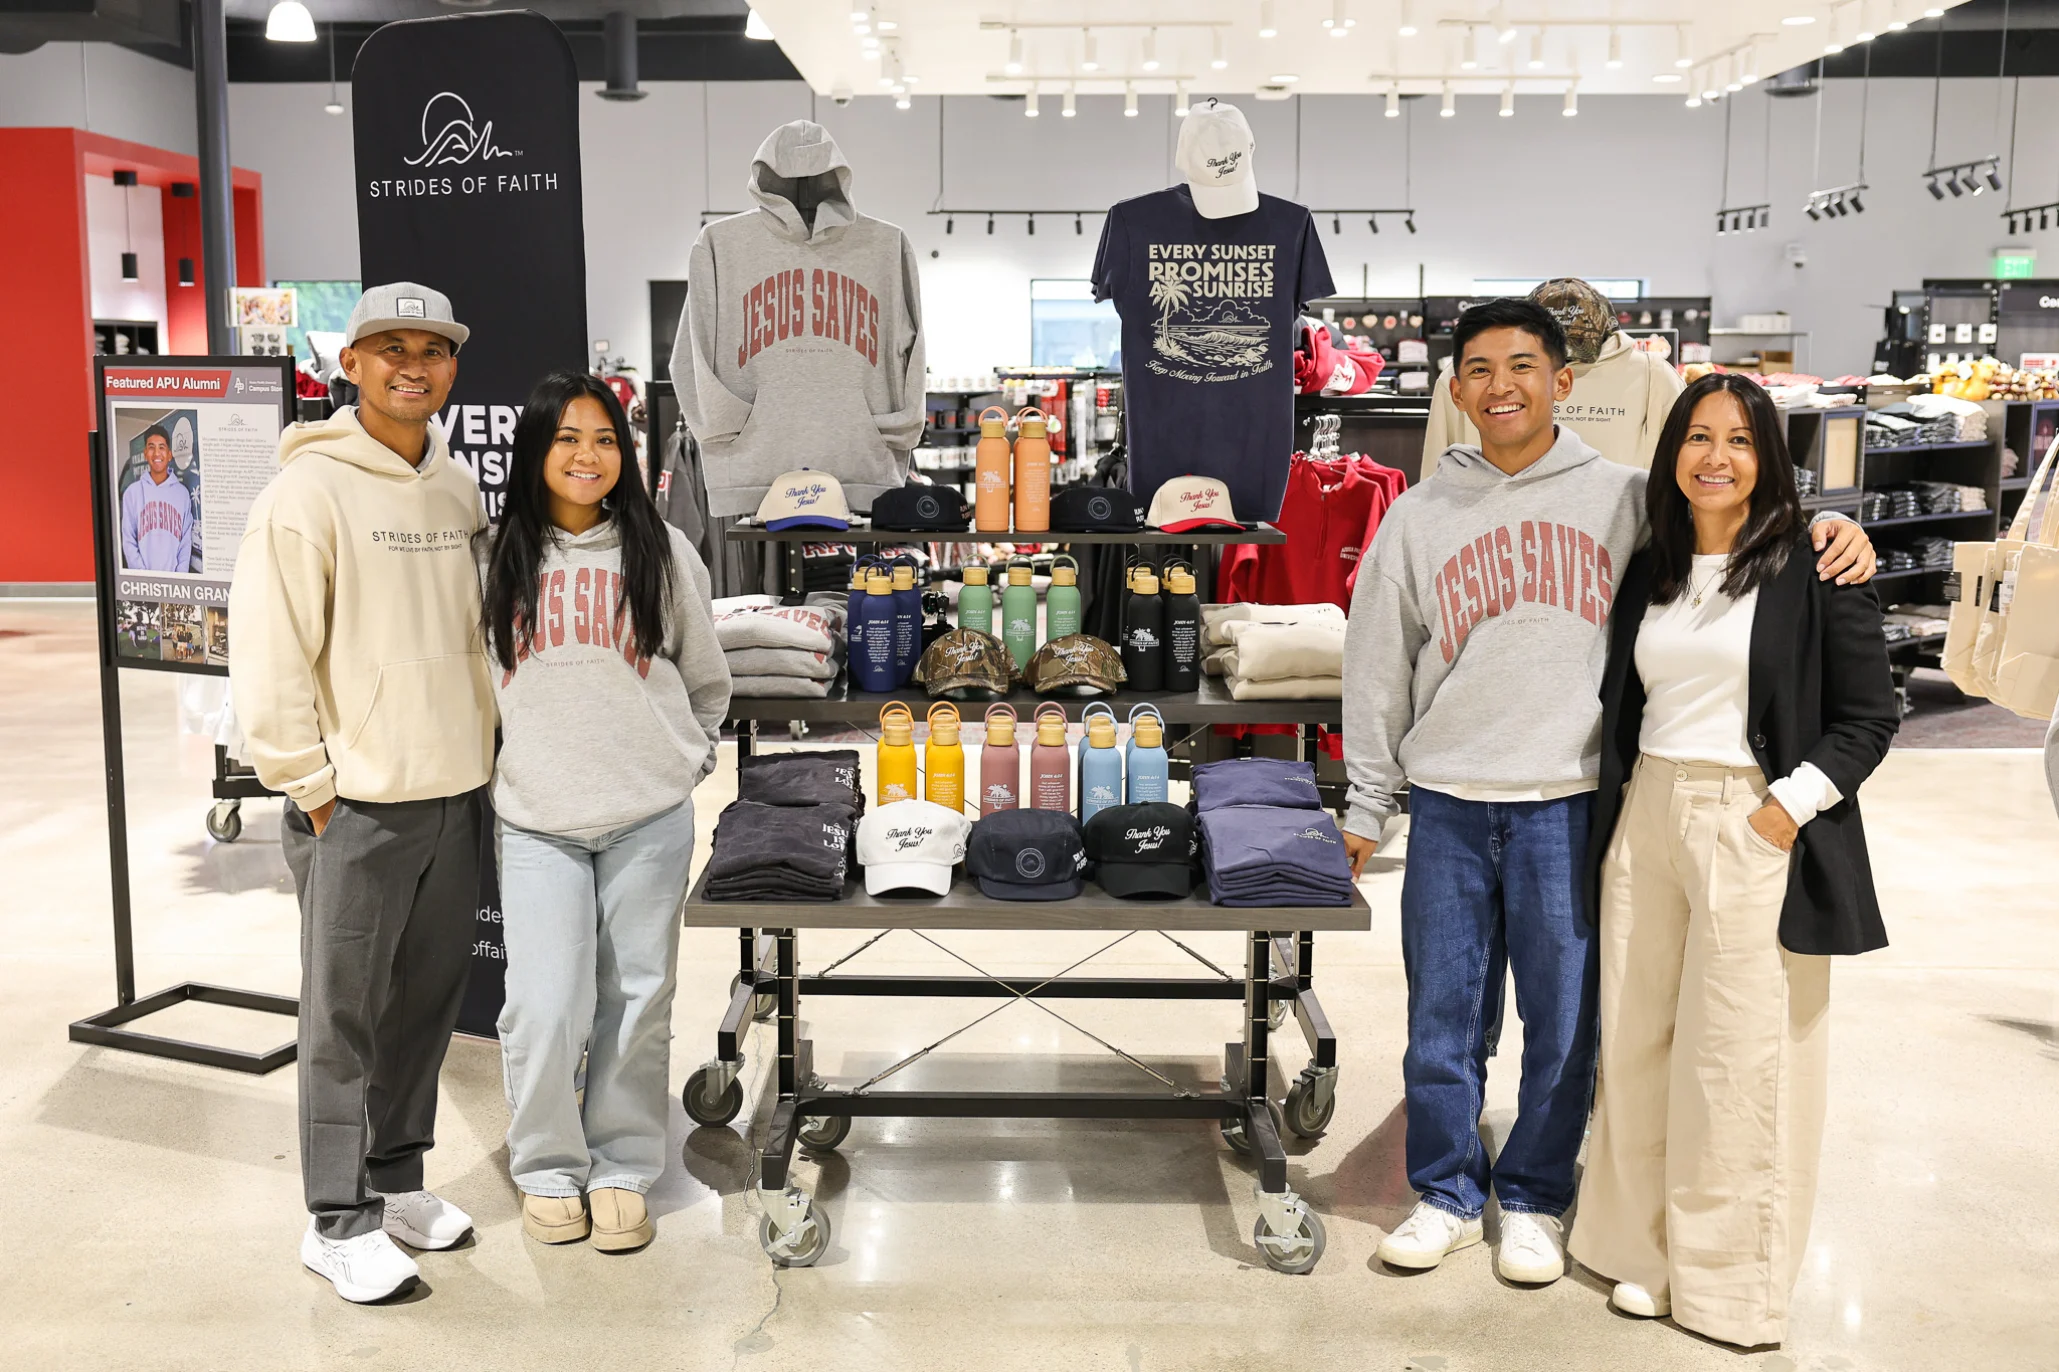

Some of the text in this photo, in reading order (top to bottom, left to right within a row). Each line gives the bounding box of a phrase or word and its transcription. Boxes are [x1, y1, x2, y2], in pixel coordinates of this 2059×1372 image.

[1206, 151, 1242, 168] Thank You
[1215, 162, 1238, 178] Jesus!
[370, 173, 557, 197] STRIDES OF FAITH
[1148, 244, 1276, 260] EVERY SUNSET
[1148, 261, 1274, 282] PROMISES
[1148, 281, 1274, 298] A SUNRISE
[738, 268, 879, 369] JESUS SAVES
[1568, 305, 1585, 317] You
[1145, 360, 1274, 384] Keep Moving Forward in Faith
[106, 376, 221, 390] Featured APU Alumni
[1566, 406, 1583, 414] OF
[1589, 407, 1625, 416] FAITH
[785, 484, 826, 498] Thank You
[1180, 488, 1219, 502] Thank You
[794, 495, 820, 509] Jesus!
[1190, 501, 1214, 512] Jesus!
[138, 502, 158, 541] JESUS
[158, 501, 182, 542] SAVES
[372, 530, 469, 543] STRIDES OF FAITH
[120, 581, 190, 599] CHRISTIAN
[1436, 520, 1612, 664] JESUS SAVES
[945, 641, 985, 657] Thank You
[1054, 642, 1094, 658] Thank You
[954, 651, 978, 666] Jesus!
[822, 823, 849, 837] JESU
[886, 827, 933, 840] Thank You
[1125, 826, 1171, 840] Thank You
[895, 838, 924, 852] Jesus!
[1135, 838, 1164, 854] Jesus!
